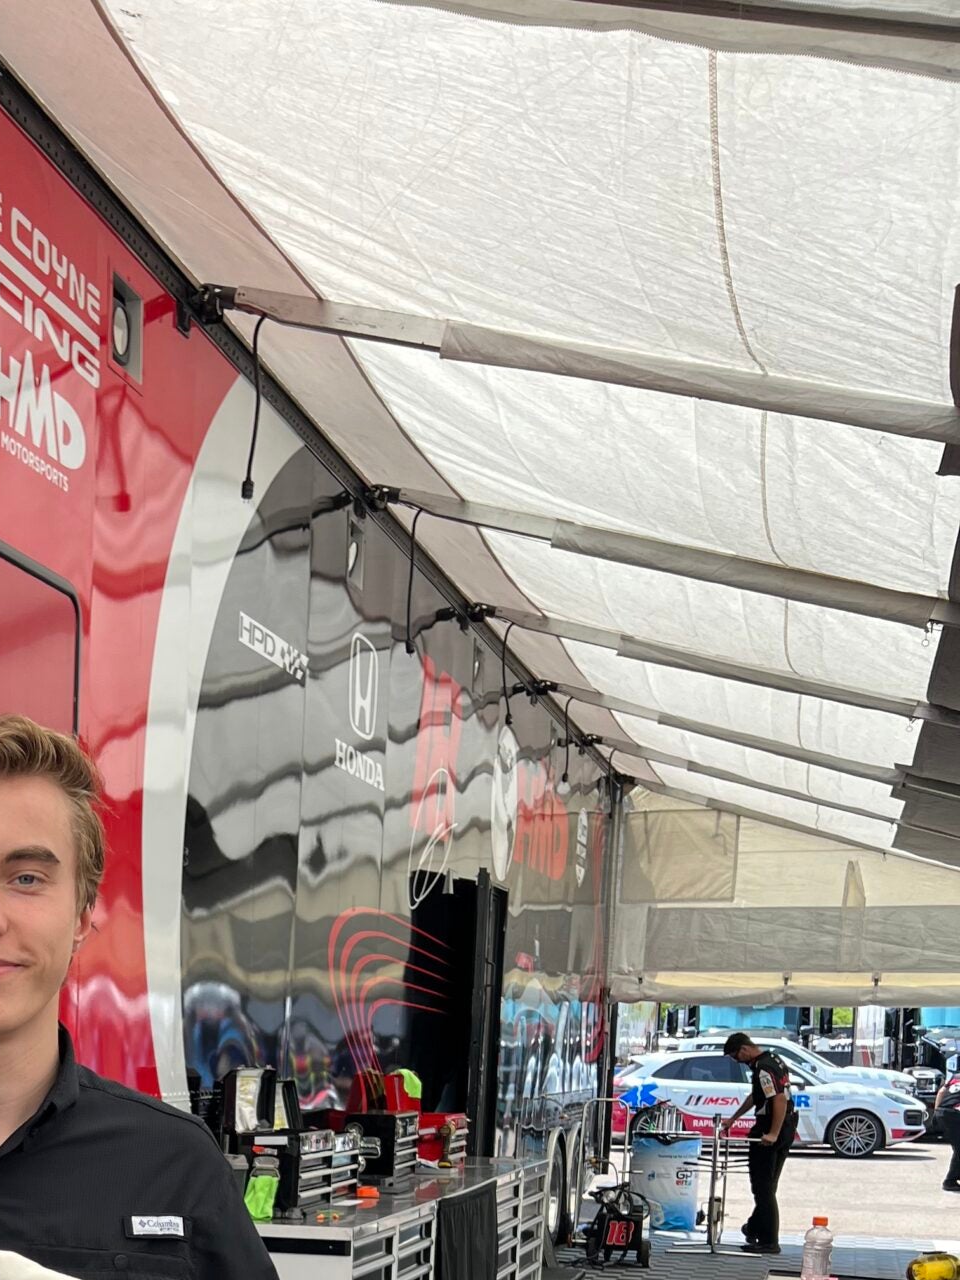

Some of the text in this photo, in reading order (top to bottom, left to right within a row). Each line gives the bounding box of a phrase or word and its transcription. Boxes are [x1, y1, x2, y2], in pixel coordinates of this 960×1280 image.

[11, 206, 101, 326] COYNE
[0, 430, 69, 493] MOTORSPORTS
[240, 615, 276, 658] HPD
[334, 738, 385, 792] HONDA
